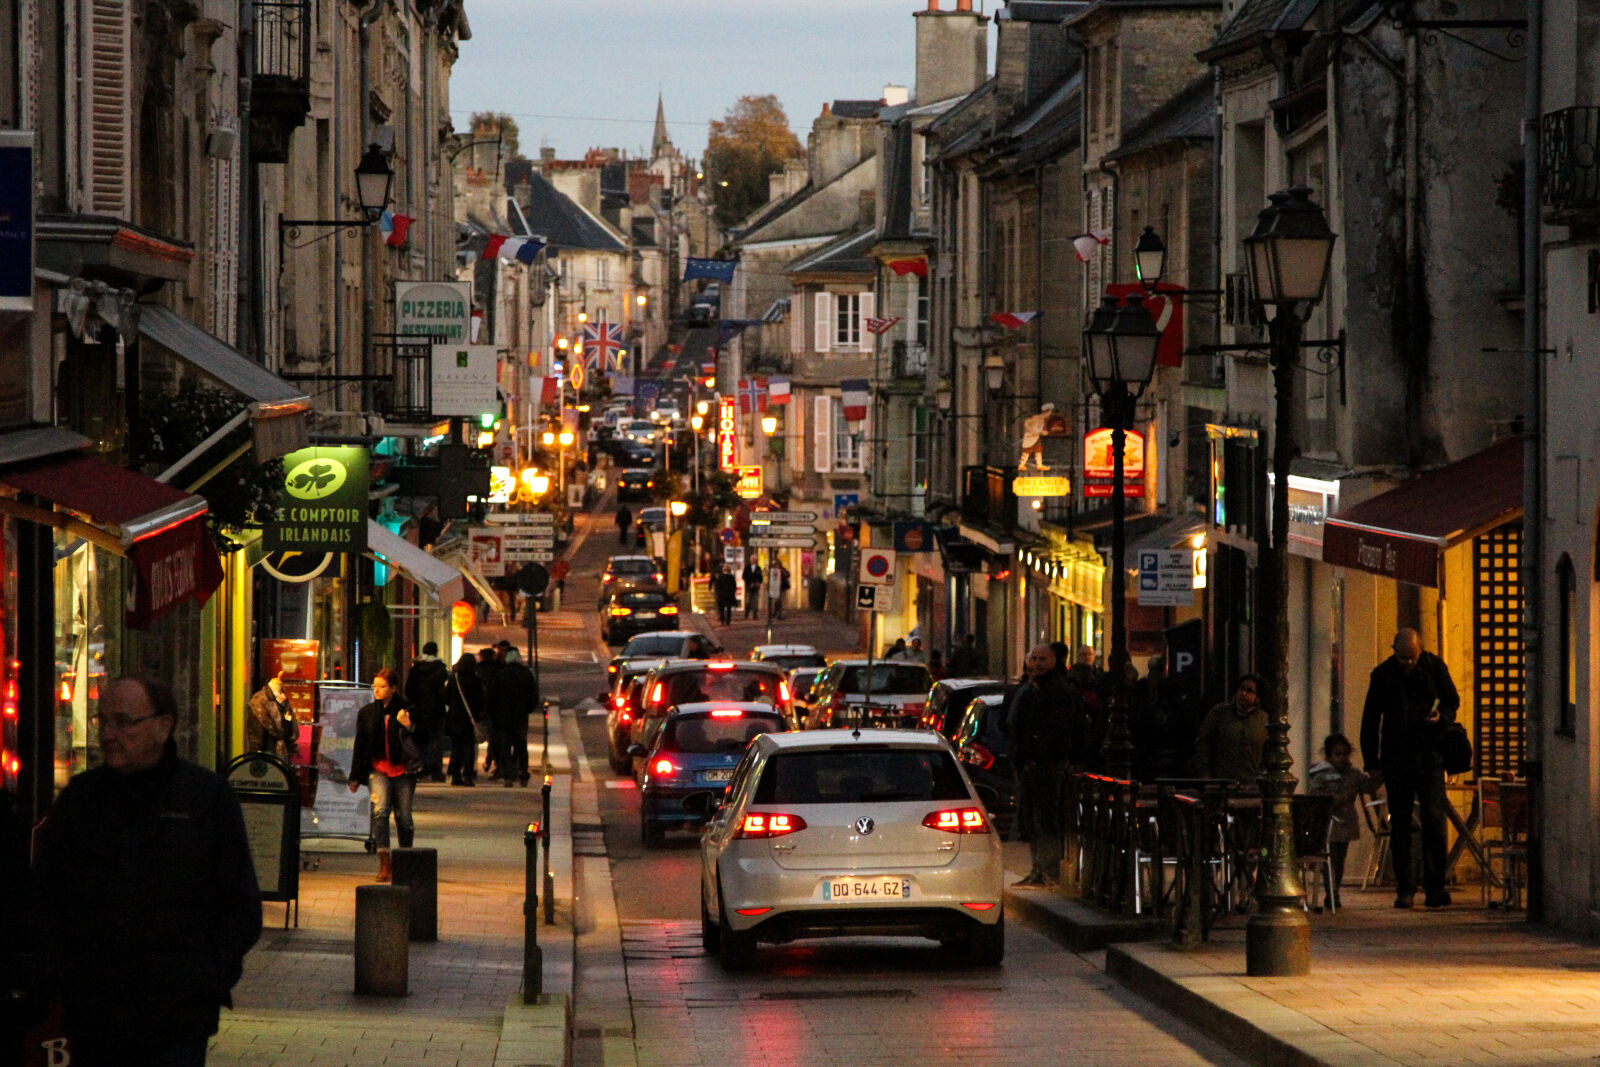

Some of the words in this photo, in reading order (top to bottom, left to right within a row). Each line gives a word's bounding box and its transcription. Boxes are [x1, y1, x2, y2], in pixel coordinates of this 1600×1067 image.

[402, 301, 465, 318] PIZZERIA
[402, 324, 462, 339] RESTAURANT
[721, 405, 734, 467] HOTEL
[1018, 478, 1064, 486] BOULANGER
[291, 508, 360, 522] COMPTOIR
[280, 527, 351, 542] IRLANDAIS
[1143, 556, 1155, 569] P
[1176, 651, 1194, 673] P
